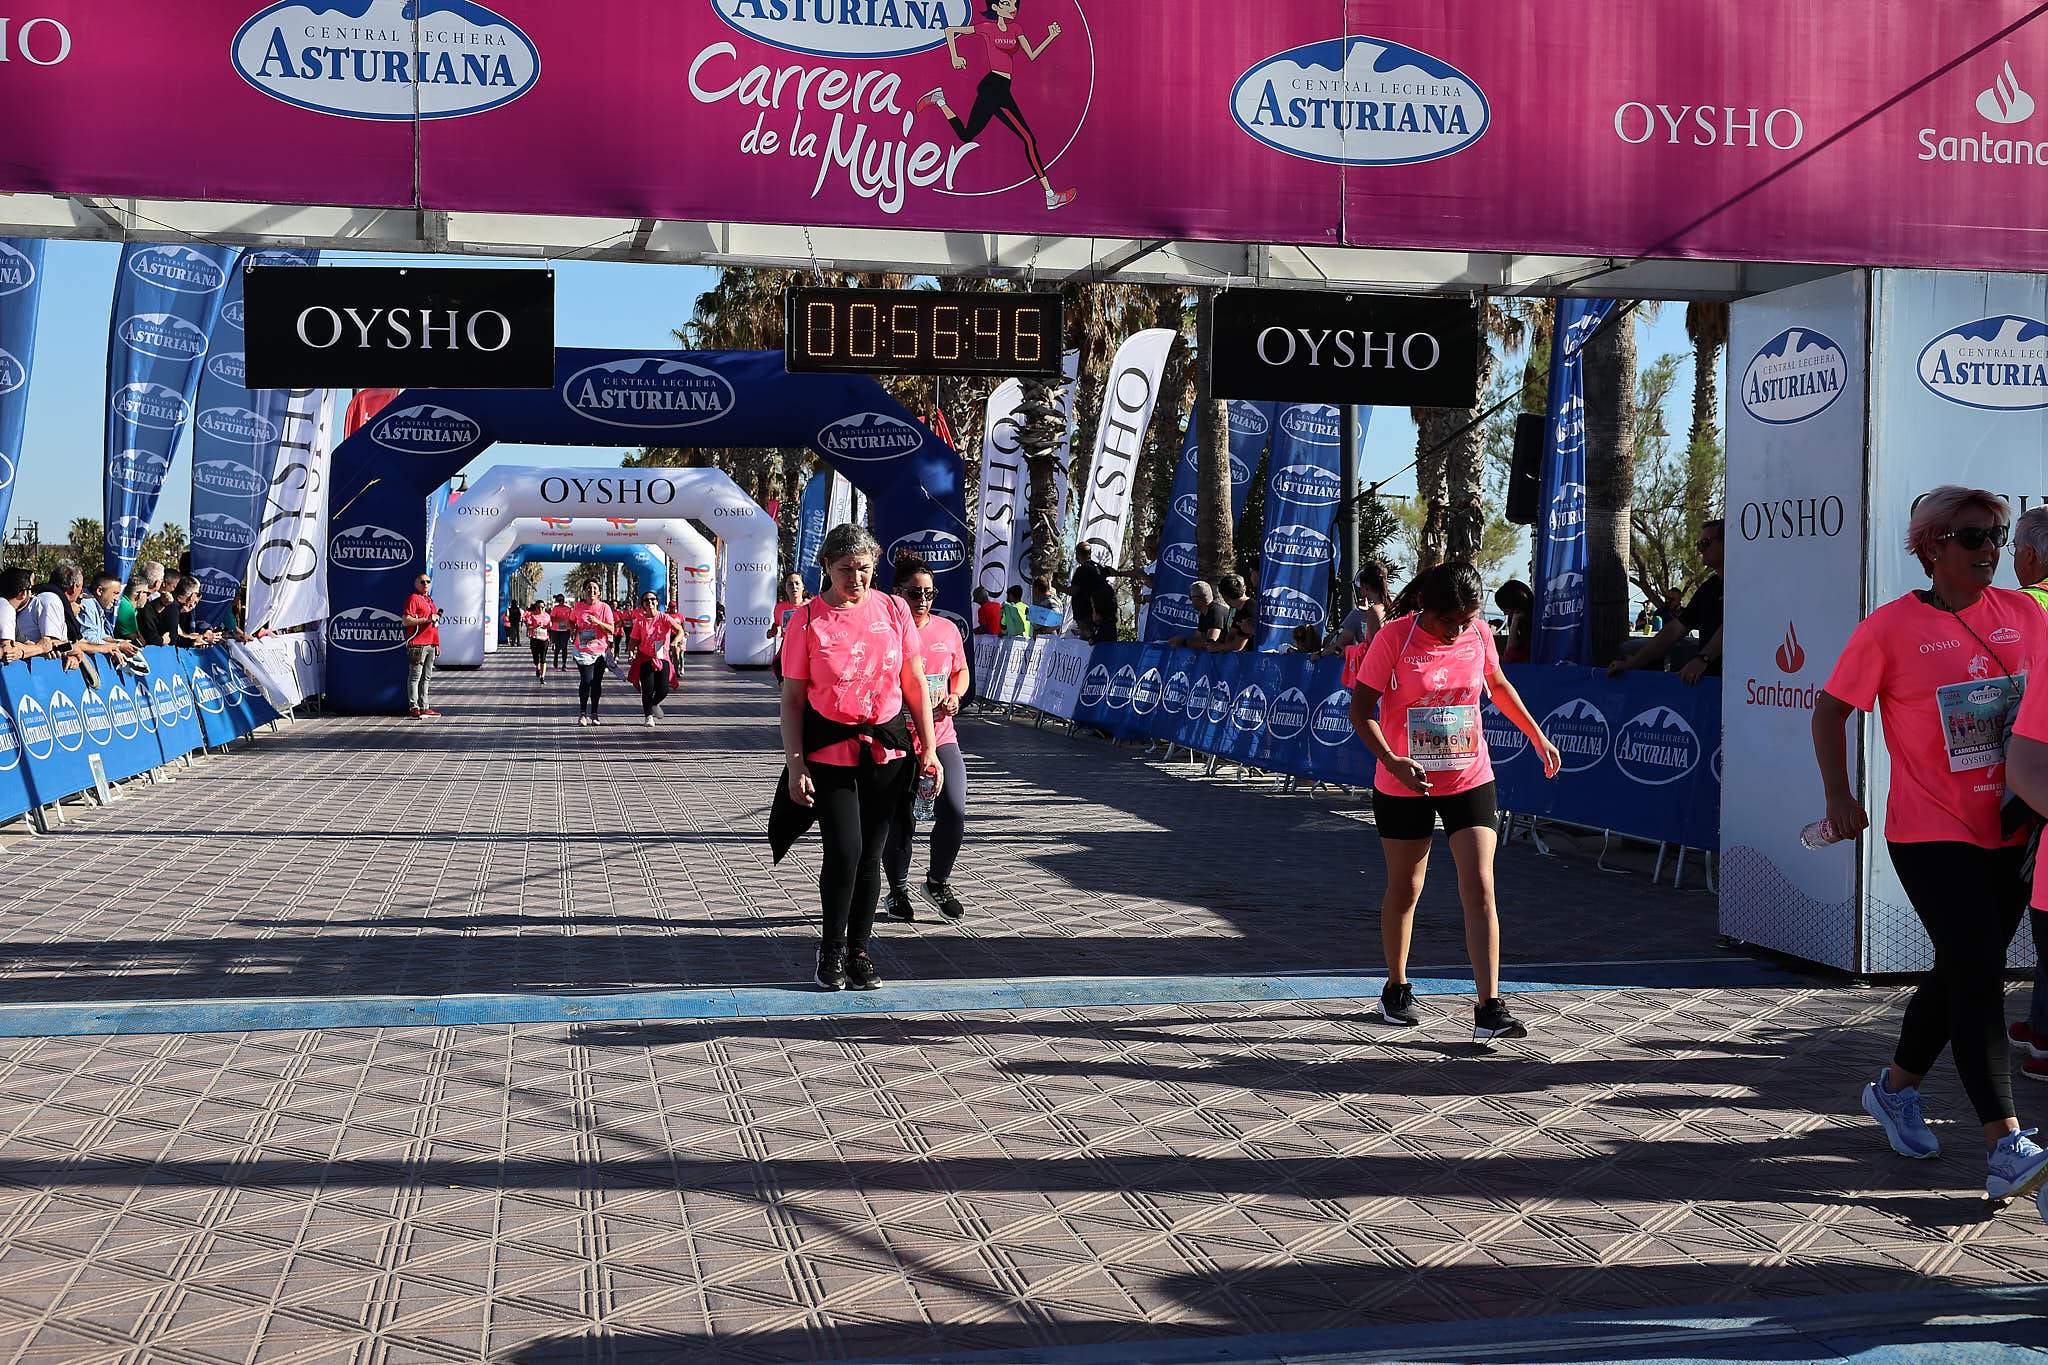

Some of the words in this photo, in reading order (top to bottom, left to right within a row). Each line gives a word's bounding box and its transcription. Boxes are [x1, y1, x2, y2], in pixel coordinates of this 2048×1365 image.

[304, 25, 400, 42] CENTRAL
[256, 26, 517, 87] ASTURIANA
[688, 41, 901, 115] Carrera
[1291, 78, 1372, 94] CENTRAL
[1381, 82, 1462, 97] LECHERA
[1251, 79, 1470, 135] ASTURIANA
[1614, 102, 1804, 150] OYSHO
[740, 112, 779, 155] de
[790, 111, 817, 157] la
[811, 111, 980, 213] Mujer
[135, 255, 217, 287] ASTURIANA
[297, 305, 512, 351] OYSHO
[807, 301, 1041, 362] 00:56:46
[1257, 326, 1440, 371] OYSHO
[1958, 347, 2016, 359] CENTRAL
[1763, 361, 1797, 376] CENTRAL
[1798, 353, 1836, 370] LECHERA
[603, 377, 657, 386] CENTRAL
[662, 378, 717, 388] LECHERA
[1747, 366, 1839, 406] ASTURIANA
[576, 377, 724, 411] ASTURIANA
[202, 415, 272, 441] ASTURIANA
[377, 422, 472, 442] ASTURIANA
[826, 431, 917, 450] ASTURIANA
[194, 470, 261, 493] ASTURIANA
[255, 388, 328, 586] OYSH
[540, 476, 676, 505] OYSHO
[457, 506, 499, 516] OYSHO
[713, 507, 754, 517] OYSHO
[979, 417, 1022, 597] OYSHO
[1740, 495, 1844, 541] OYSHO
[334, 541, 408, 560] ASTURIANA
[1165, 549, 1197, 571] ASTUR
[439, 561, 478, 571] OYSHO
[734, 562, 771, 572] OYSHO
[199, 584, 236, 599] URIANA
[438, 615, 477, 625] OYSHO
[733, 616, 770, 626] OYSHO
[1154, 602, 1200, 624] ASTURIAN
[1260, 605, 1317, 622] TURIANA
[332, 623, 406, 641] ASTURIANA
[1919, 639, 1961, 654] OYSHO
[1047, 651, 1082, 686] OYSHO
[1404, 655, 1434, 664] OYSHO
[1618, 730, 1689, 769] ASTURIANA
[1961, 753, 1992, 766] OYSHO
